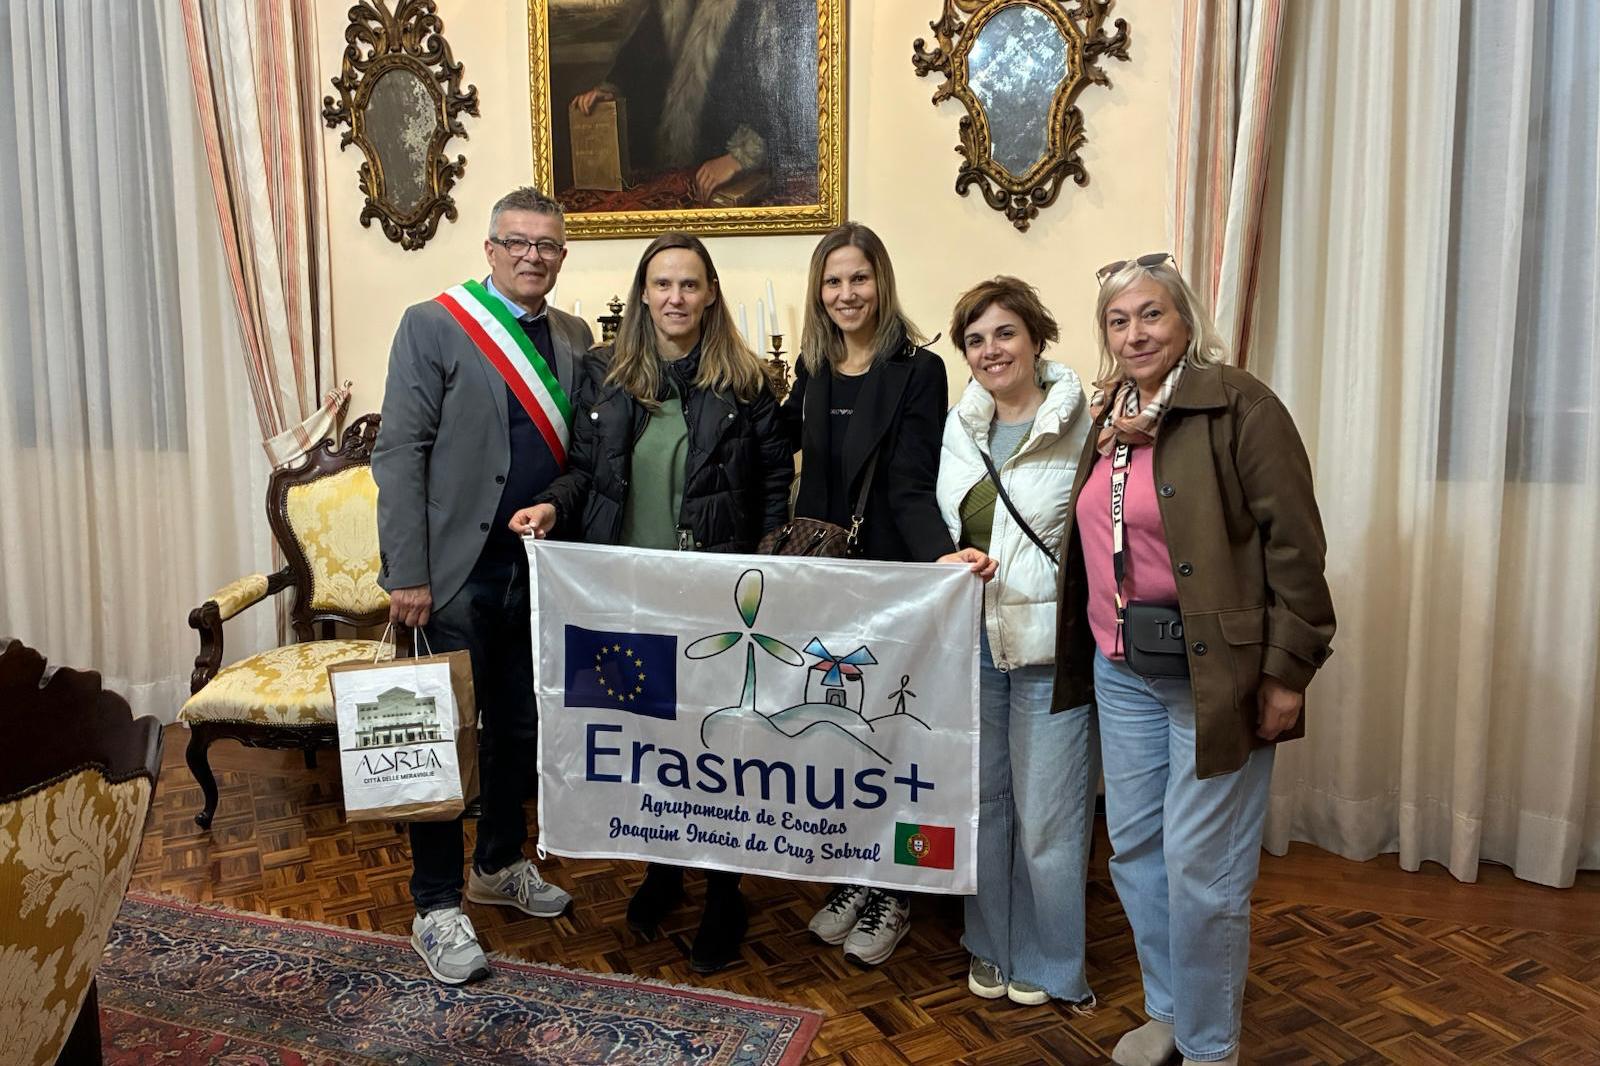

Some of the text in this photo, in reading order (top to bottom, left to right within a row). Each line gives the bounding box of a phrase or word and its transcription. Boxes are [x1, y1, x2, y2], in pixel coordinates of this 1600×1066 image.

[1113, 482, 1123, 527] TOUS
[585, 723, 935, 810] Erasmus+
[640, 793, 848, 835] Agrupamento de Escolas
[609, 816, 881, 864] Joaquim Inácio da Cruz Sobral
